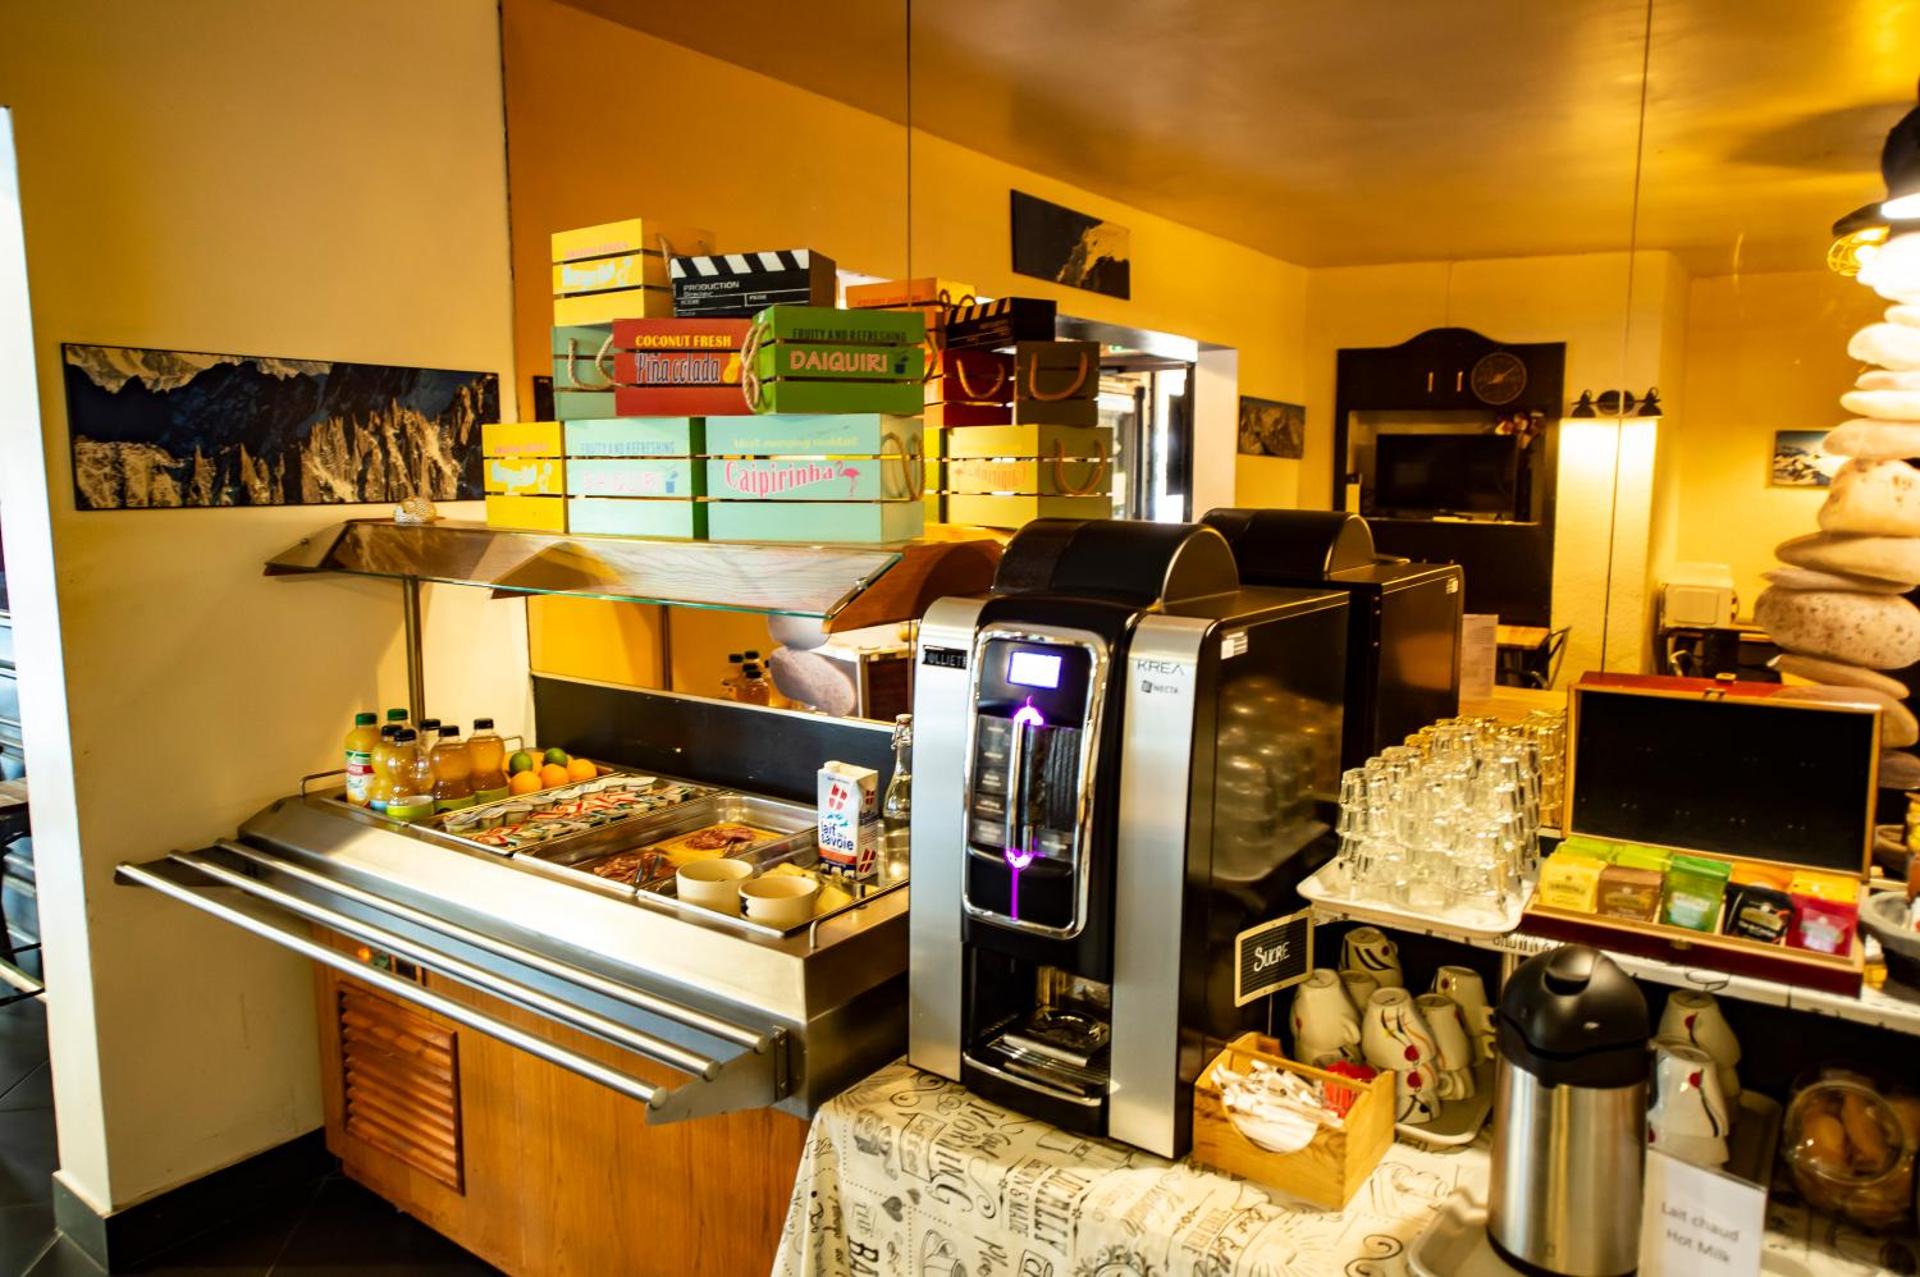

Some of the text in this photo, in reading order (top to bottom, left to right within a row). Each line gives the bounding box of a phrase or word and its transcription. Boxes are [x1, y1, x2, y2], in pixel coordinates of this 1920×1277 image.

[683, 281, 740, 292] PRODUCTION
[635, 335, 732, 348] COCONUT FRESH
[672, 350, 720, 384] colada
[789, 350, 888, 374] DAIQUIRI
[725, 459, 834, 499] Caipirinha
[1661, 1201, 1740, 1243] Lait chaud
[1666, 1227, 1693, 1250] Hot
